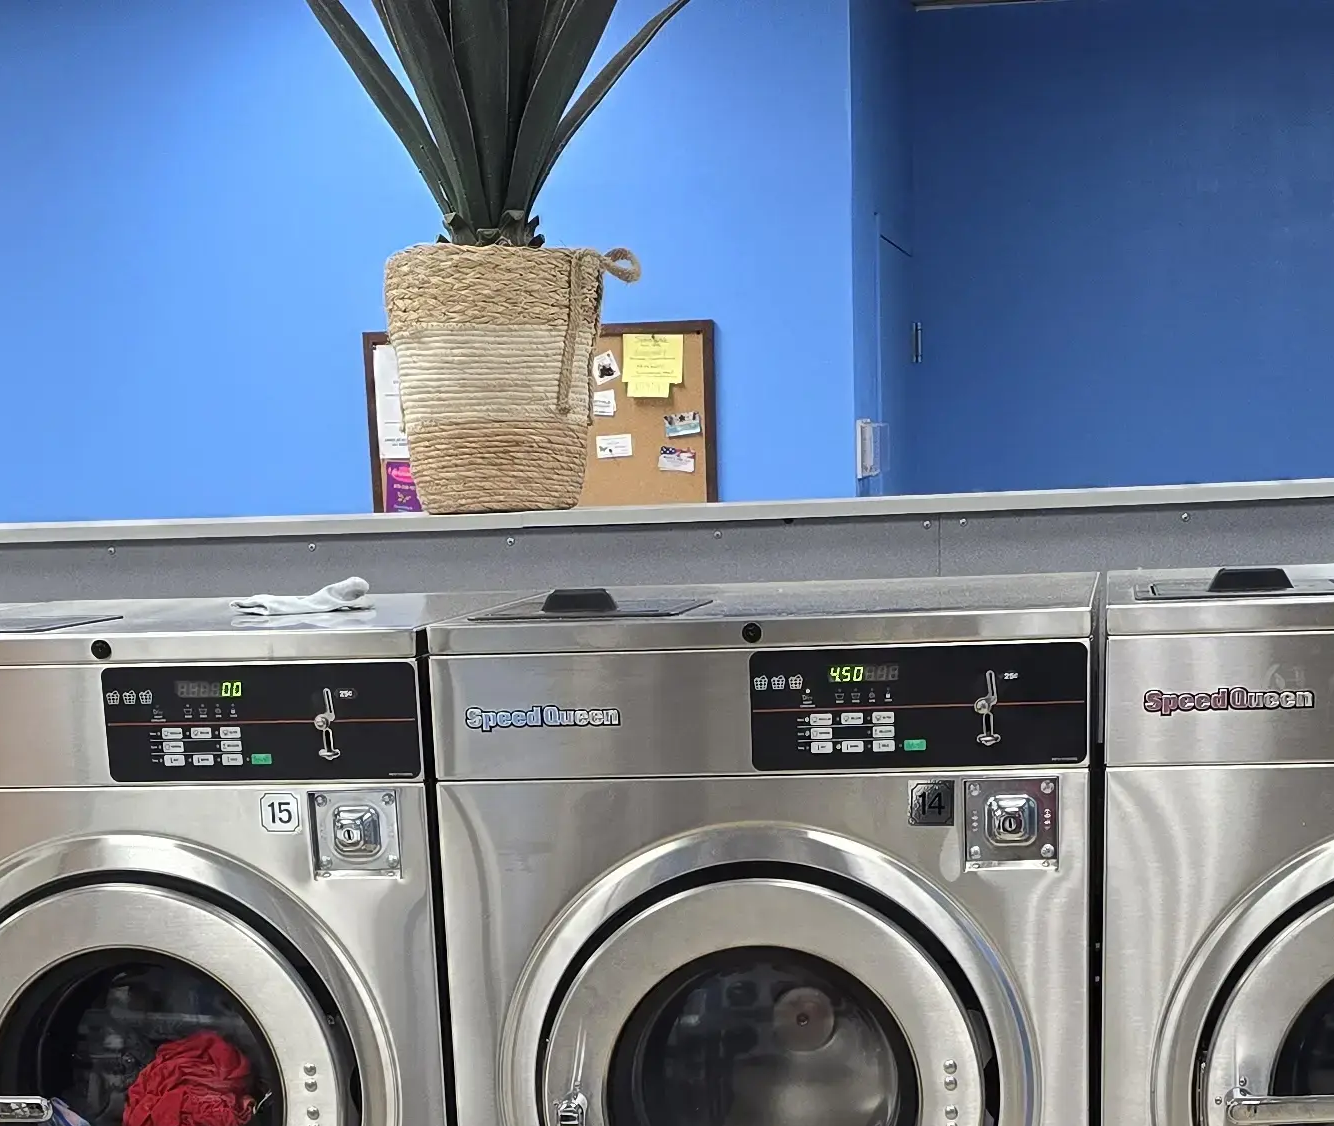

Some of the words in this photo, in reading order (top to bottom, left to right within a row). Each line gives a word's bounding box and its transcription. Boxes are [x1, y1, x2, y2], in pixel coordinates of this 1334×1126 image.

[1144, 688, 1229, 716] Speed
[1229, 687, 1315, 710] Queen
[465, 706, 542, 732] Speed
[542, 705, 621, 726] Queen
[266, 801, 293, 825] 15
[917, 792, 946, 816] 14
